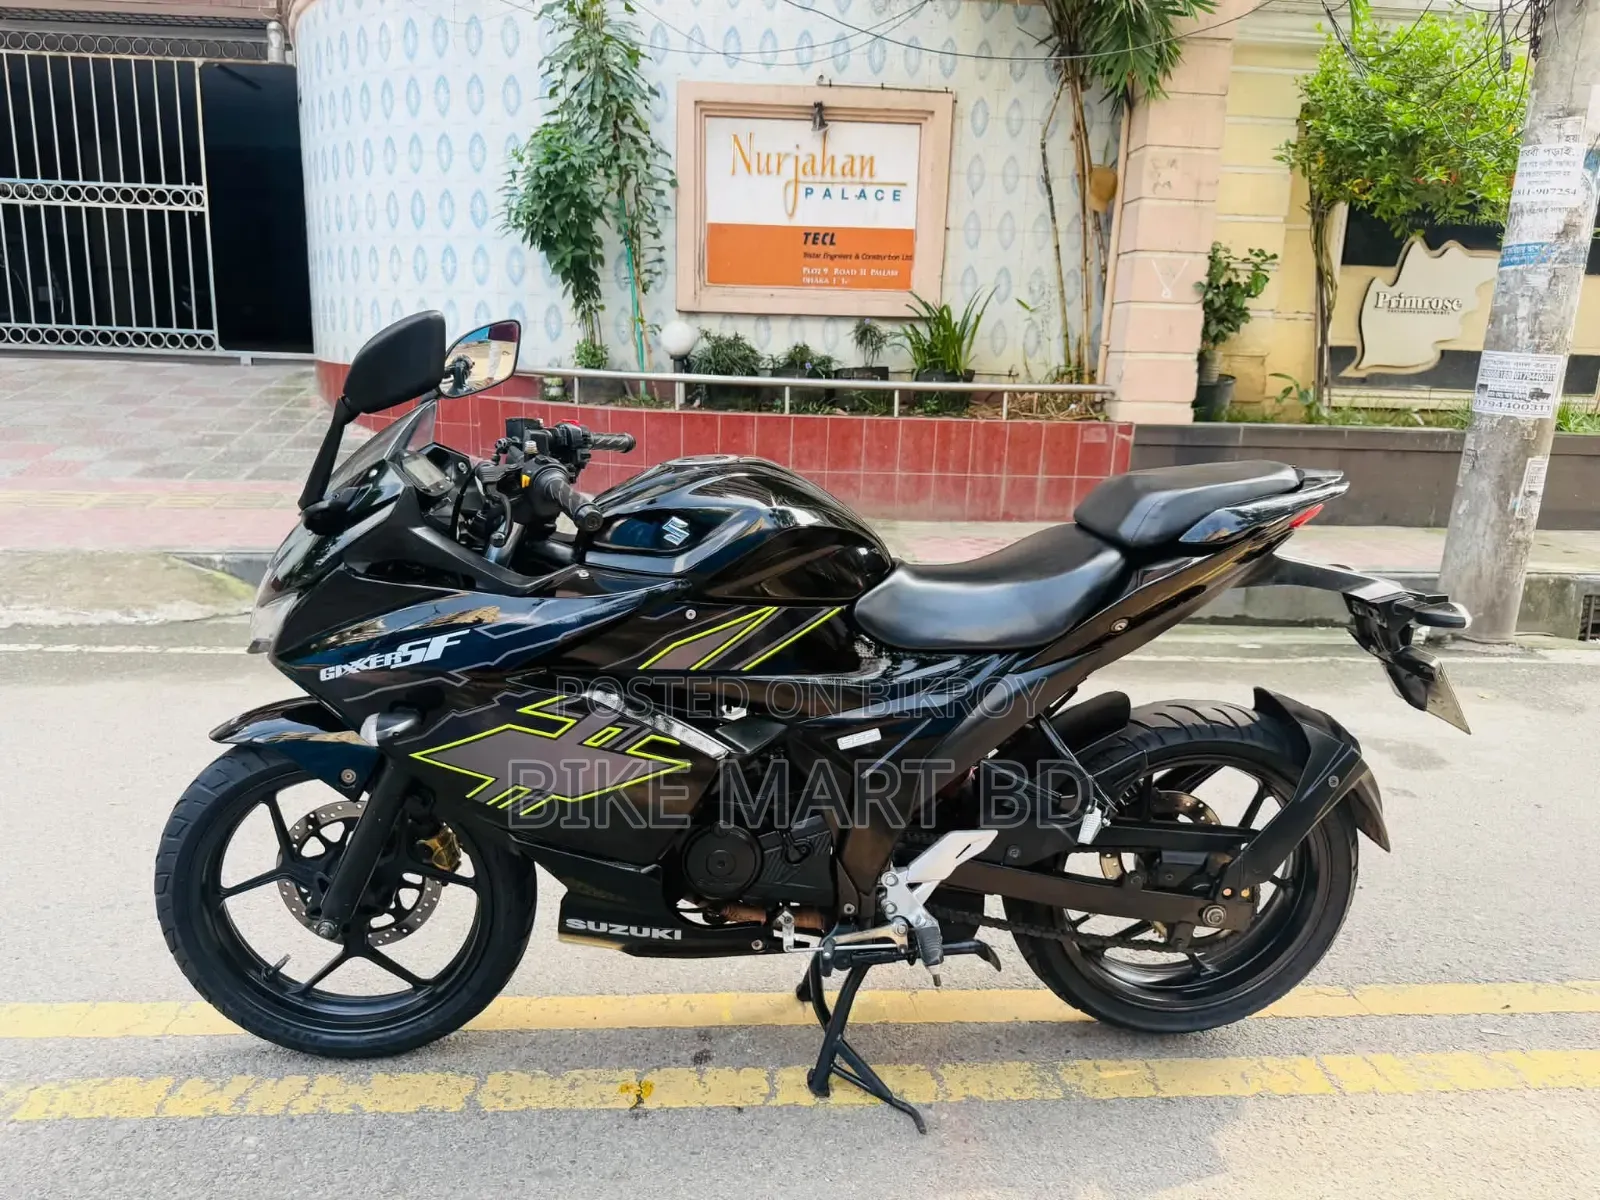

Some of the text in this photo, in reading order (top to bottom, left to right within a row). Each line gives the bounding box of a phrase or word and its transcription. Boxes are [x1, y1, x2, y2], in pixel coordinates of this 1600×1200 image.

[730, 129, 876, 219] Nurjahan
[804, 187, 902, 202] PALACE
[802, 231, 837, 246] TECL
[833, 267, 857, 276] ROAD
[1374, 291, 1462, 311] Primrose
[566, 918, 682, 940] SUZUKI
